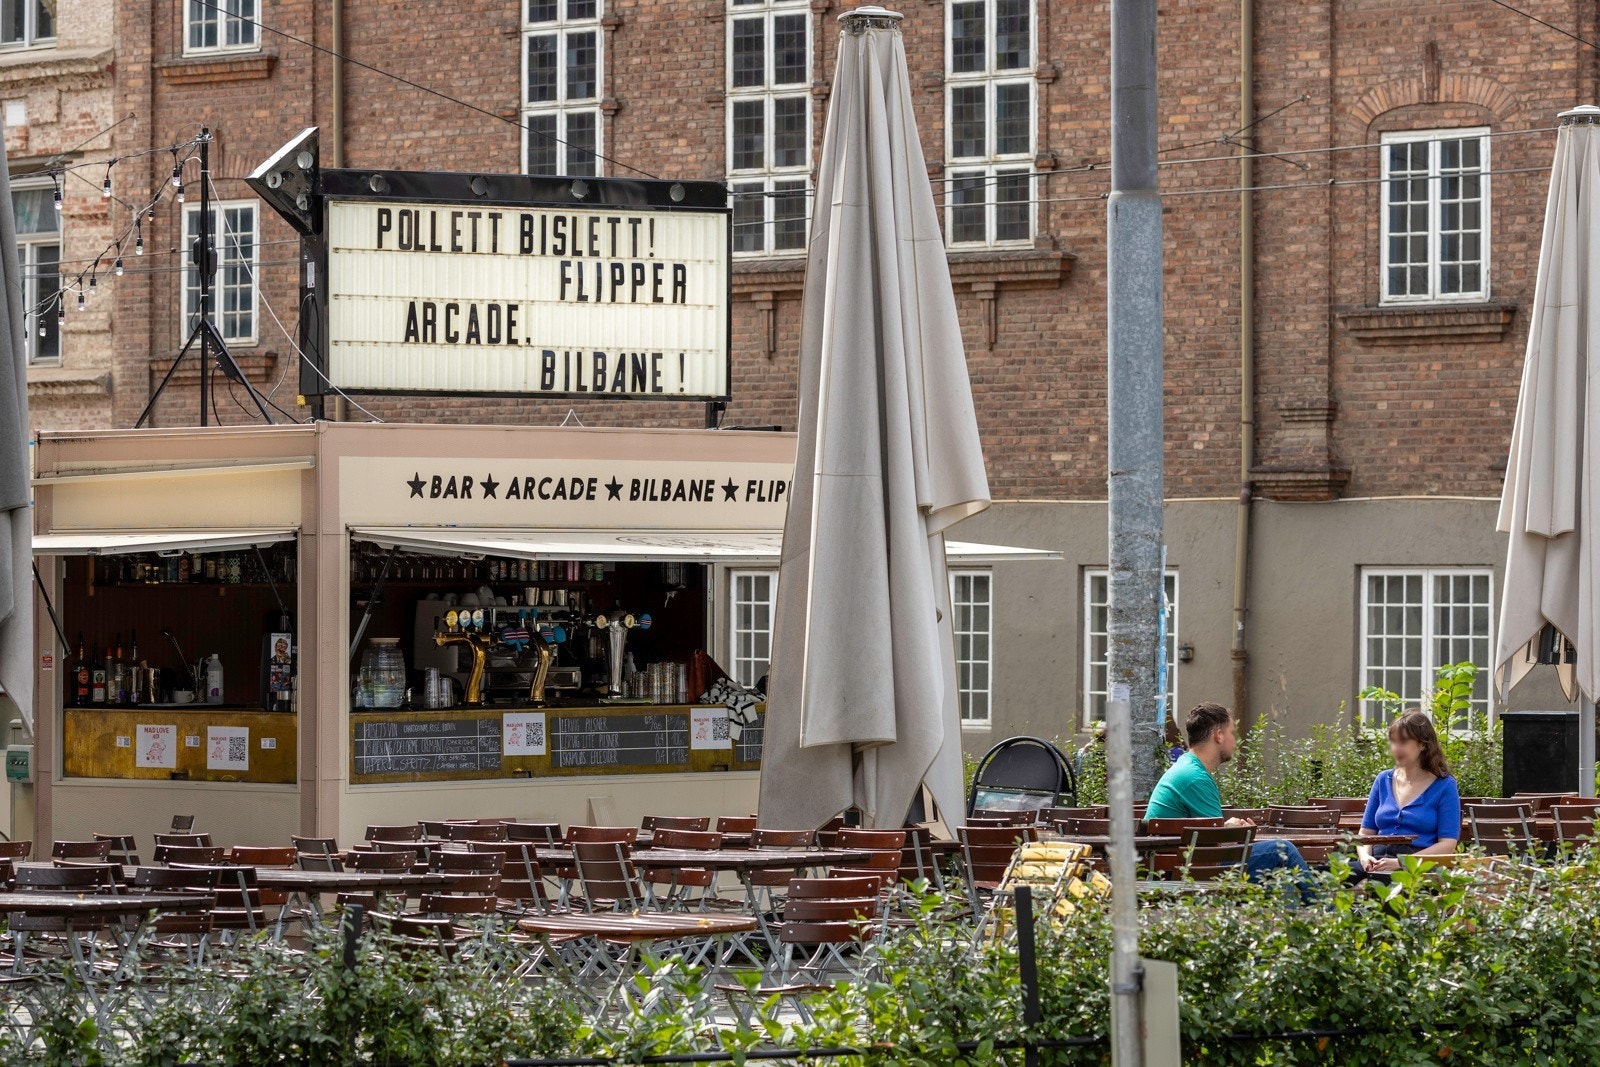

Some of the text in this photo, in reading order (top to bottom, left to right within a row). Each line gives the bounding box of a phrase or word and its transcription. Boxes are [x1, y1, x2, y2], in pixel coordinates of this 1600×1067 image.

[377, 207, 655, 258] POLLETT BISLETT!
[560, 260, 687, 304] FLIPPER
[429, 475, 474, 500] BAR
[505, 476, 598, 501] ARCADE
[629, 478, 716, 502] BILBANE
